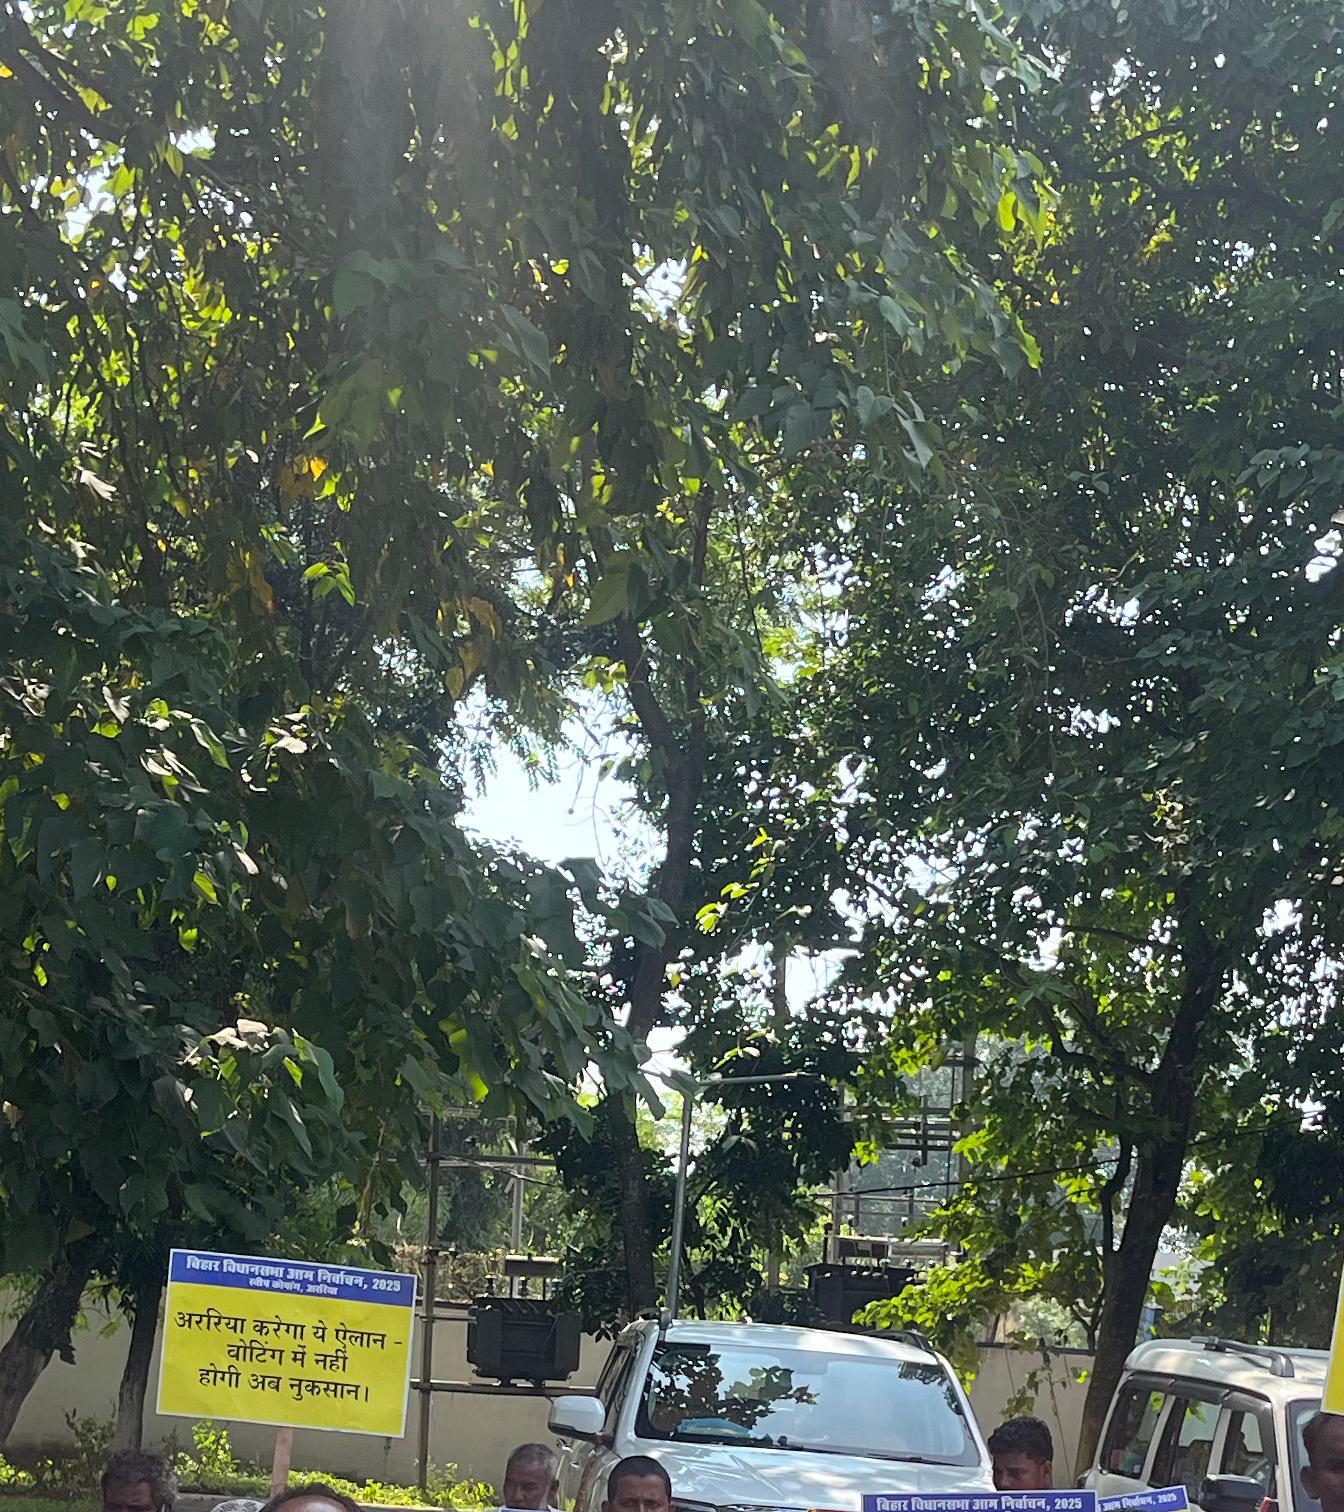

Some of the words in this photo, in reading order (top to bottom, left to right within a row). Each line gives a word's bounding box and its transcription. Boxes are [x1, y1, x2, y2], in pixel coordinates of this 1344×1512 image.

[186, 1256, 219, 1272] बिहार
[222, 1258, 285, 1279] विधानसभा
[286, 1267, 315, 1282] आम
[372, 1278, 402, 1292] 2025
[174, 1307, 247, 1335] अररिया
[252, 1314, 306, 1342] करेगा
[312, 1319, 329, 1344] ये
[334, 1322, 388, 1350] ऐलान
[227, 1338, 286, 1367] वोटिंग
[291, 1344, 307, 1369] में
[314, 1347, 349, 1373] नहीं
[198, 1362, 243, 1389] होगी
[247, 1373, 283, 1393] अब
[288, 1377, 371, 1404] नुकसान।
